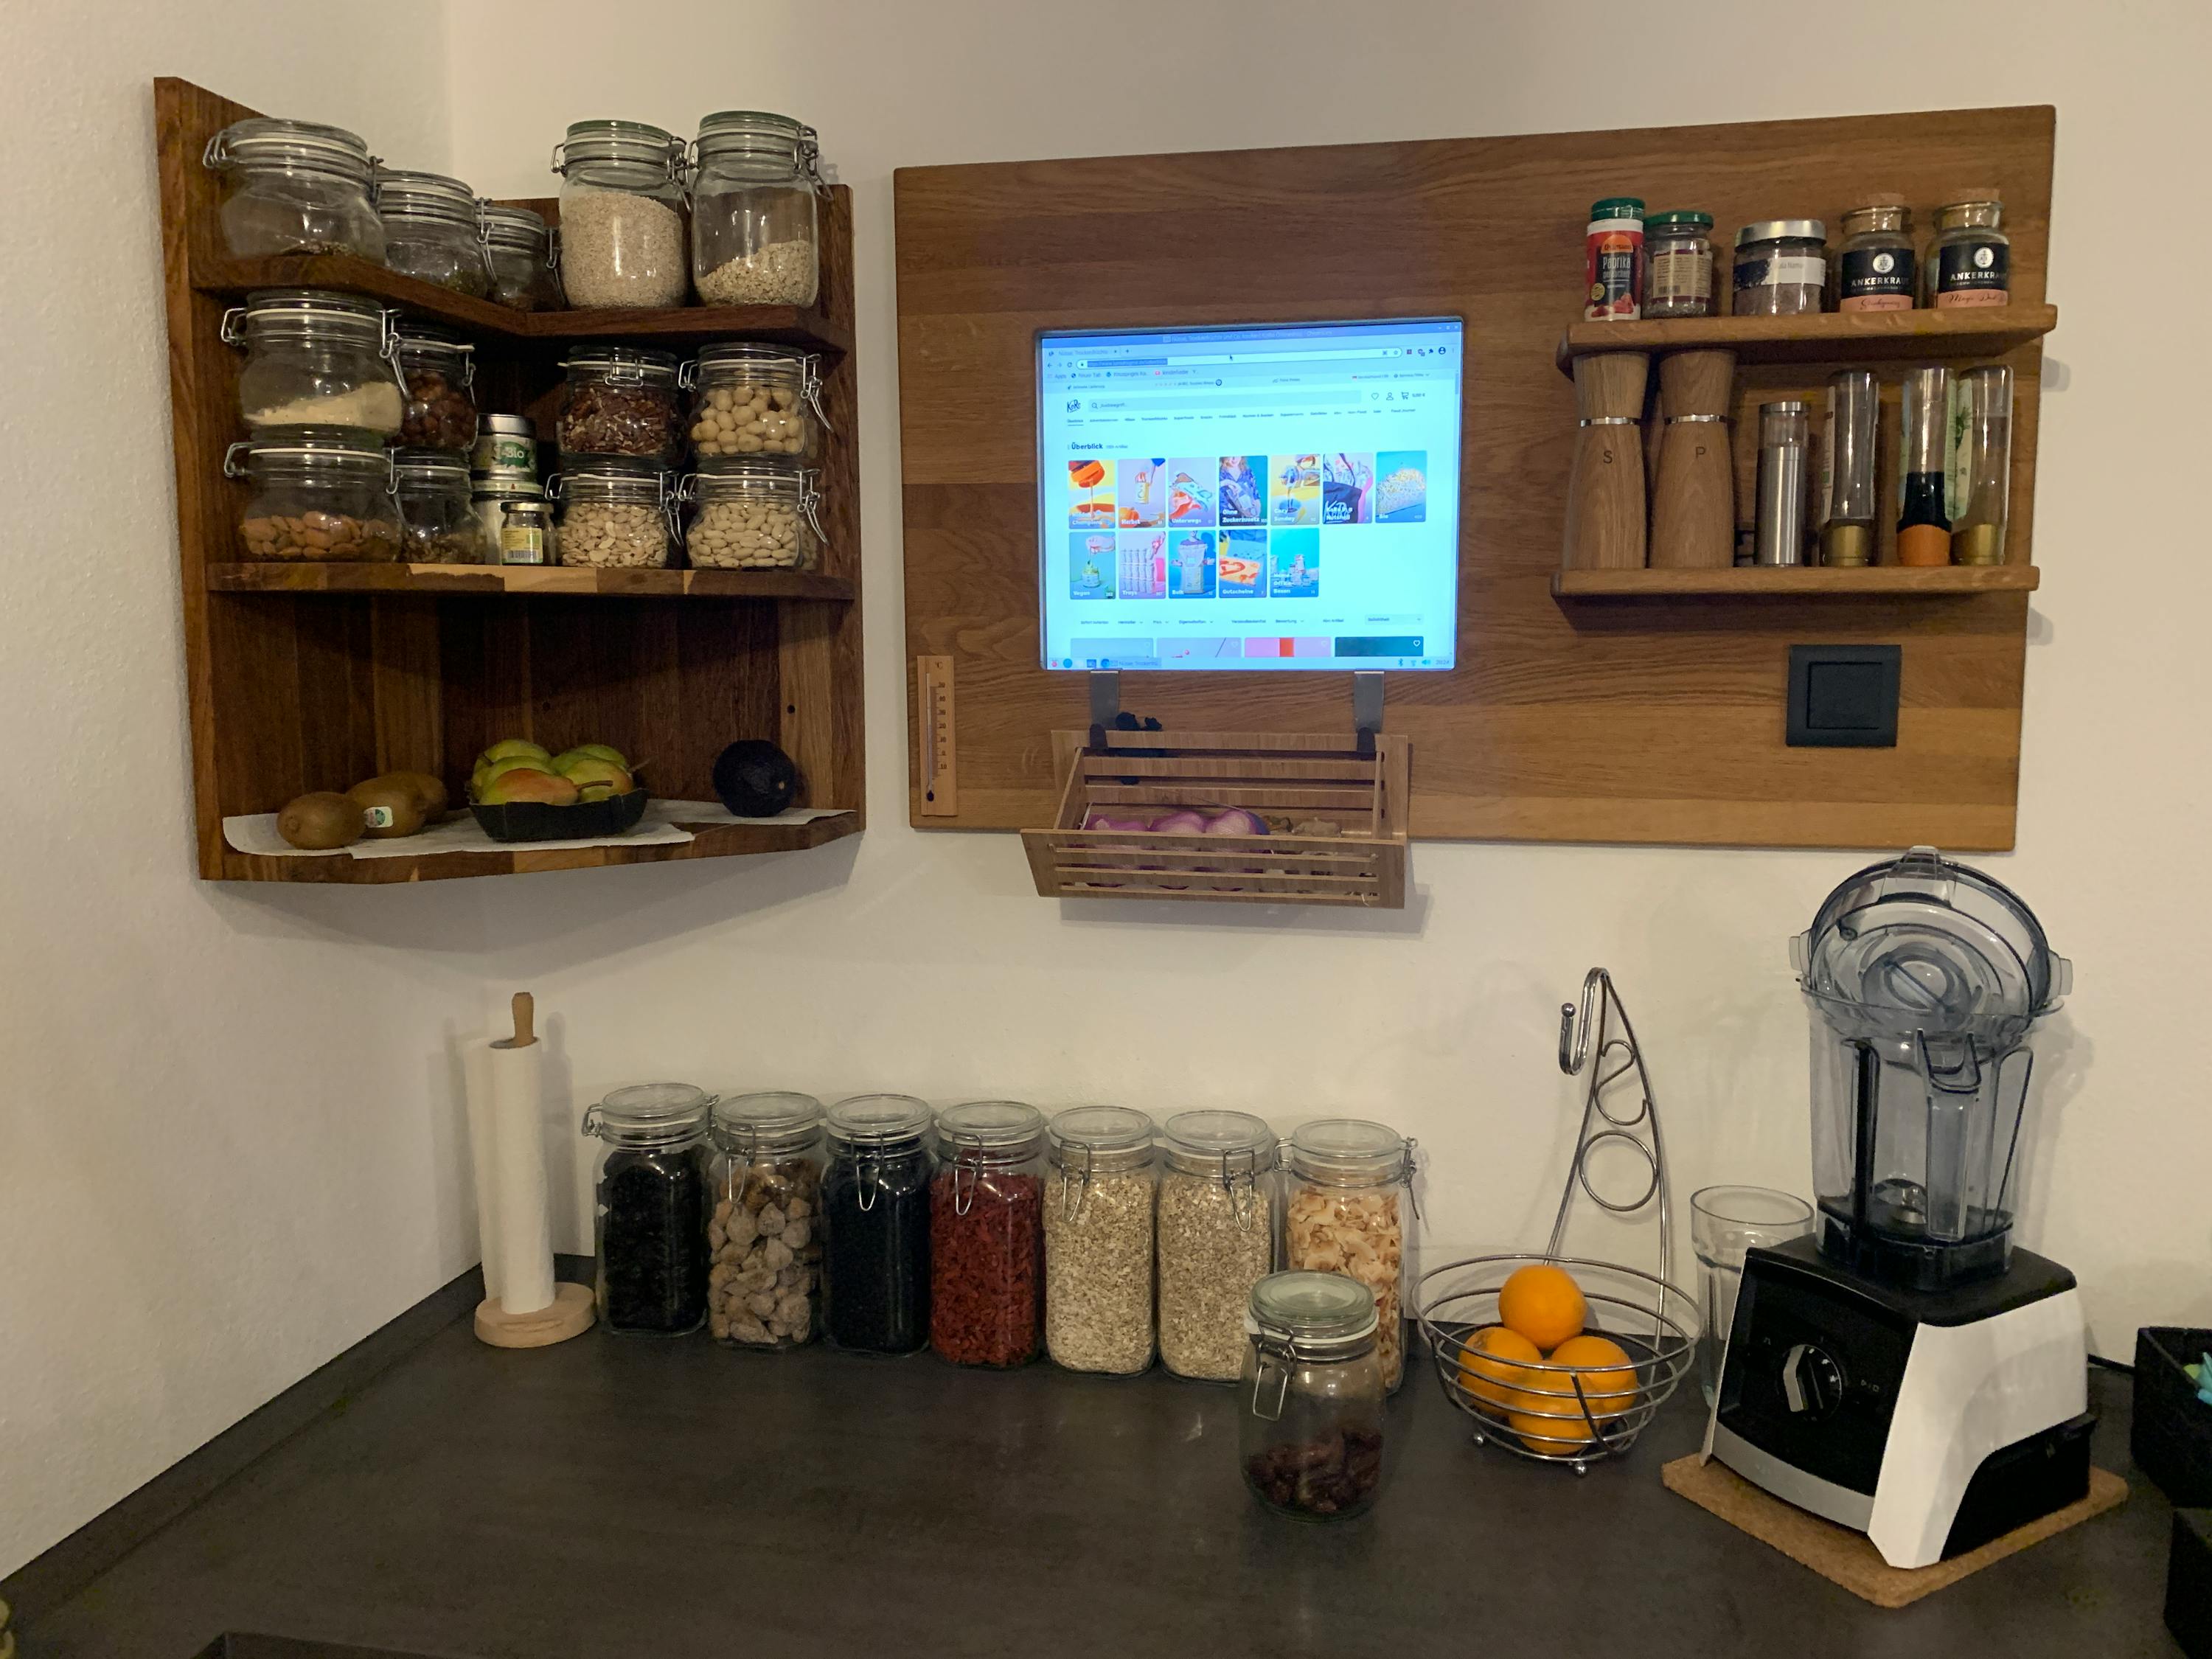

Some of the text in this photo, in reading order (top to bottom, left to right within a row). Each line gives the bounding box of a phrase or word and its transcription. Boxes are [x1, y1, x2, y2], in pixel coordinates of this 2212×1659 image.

[1602, 256, 1631, 270] Paprika
[1071, 442, 1104, 450] Überblick
[1695, 446, 1706, 459] P
[1603, 450, 1613, 465] S
